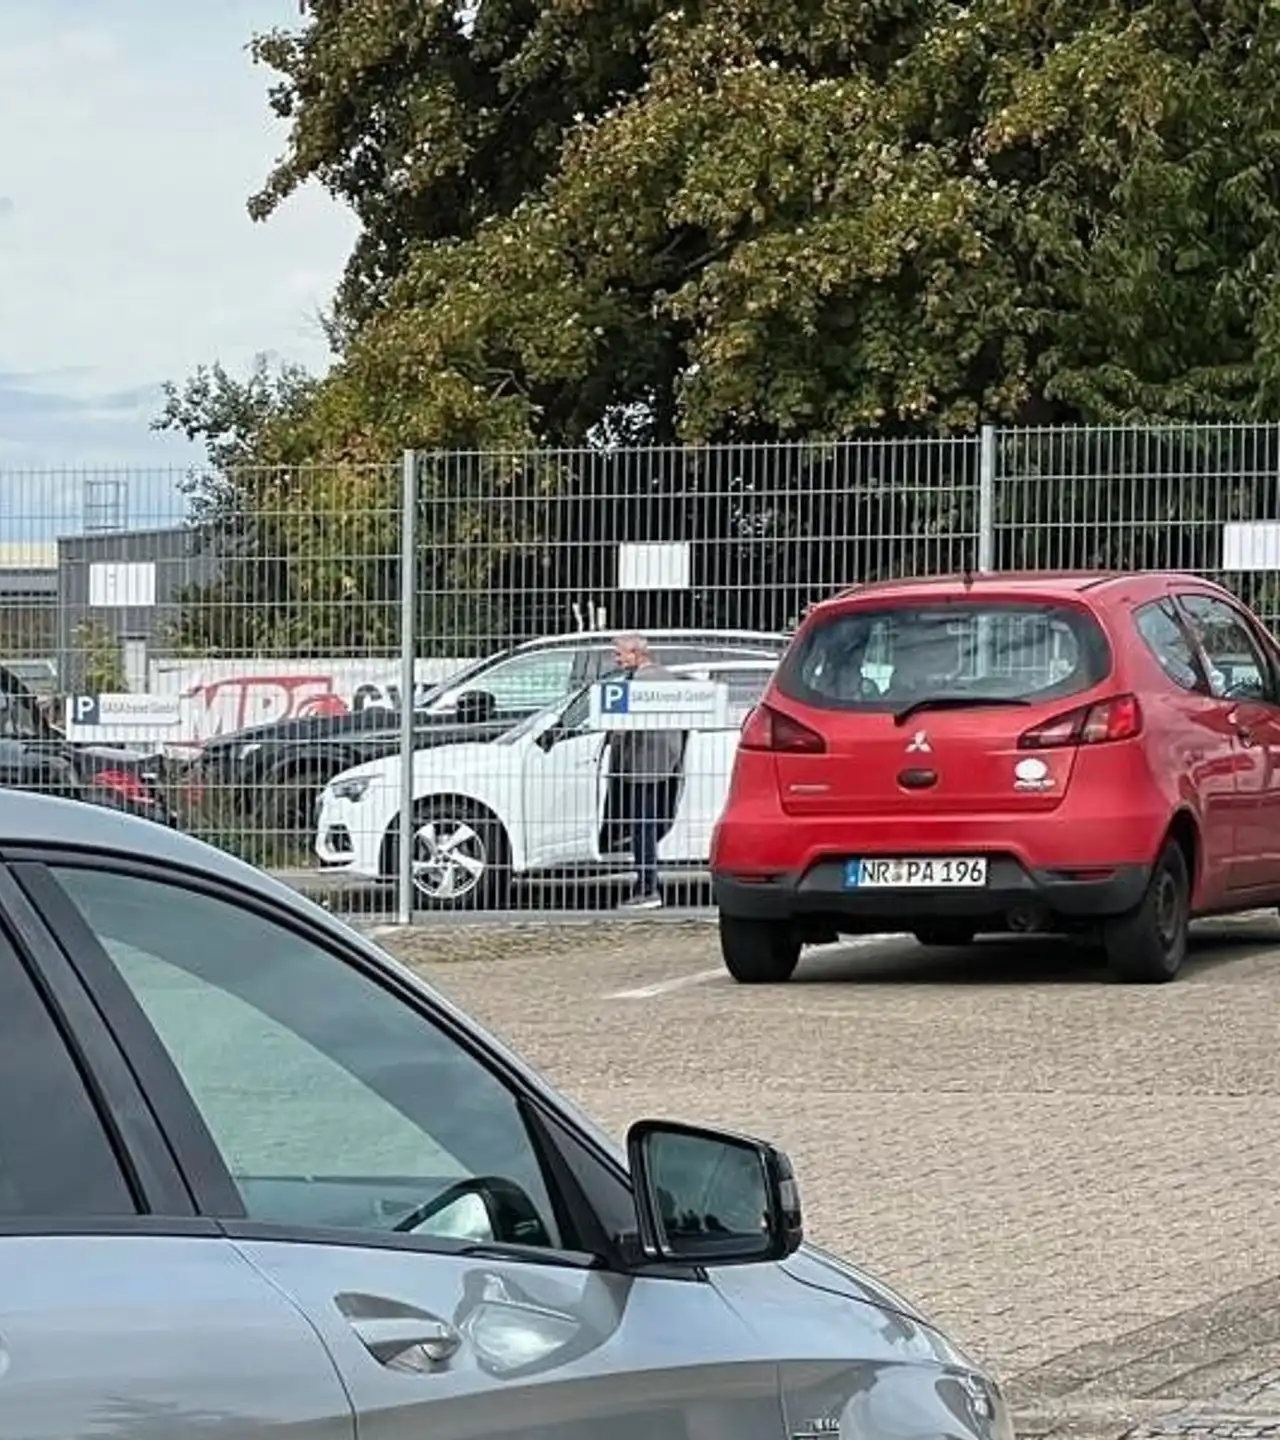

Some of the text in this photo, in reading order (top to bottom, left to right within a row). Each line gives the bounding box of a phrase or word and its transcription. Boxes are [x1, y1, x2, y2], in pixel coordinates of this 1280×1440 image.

[77, 696, 94, 720] P
[605, 684, 623, 710] P
[861, 860, 983, 883] NR PA 196
